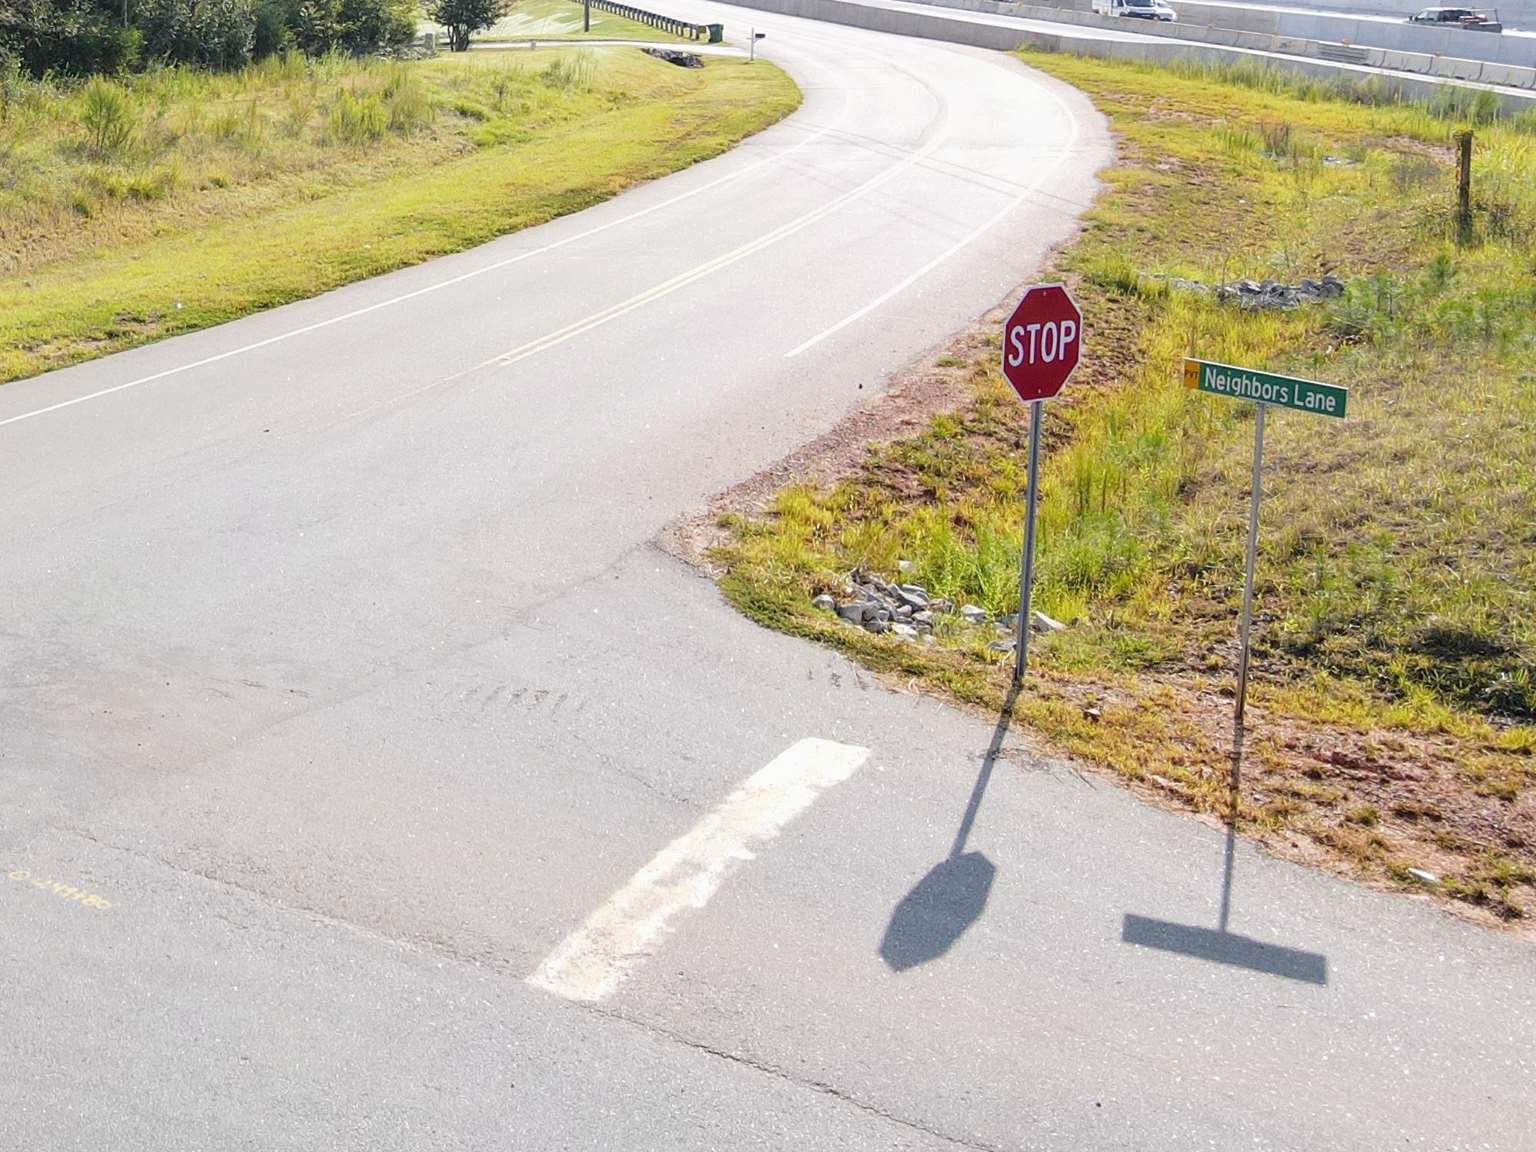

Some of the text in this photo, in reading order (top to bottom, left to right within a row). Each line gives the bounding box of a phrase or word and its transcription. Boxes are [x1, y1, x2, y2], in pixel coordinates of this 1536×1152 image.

[1008, 320, 1076, 367] STOP
[1204, 367, 1336, 412] Neighbors Lane
